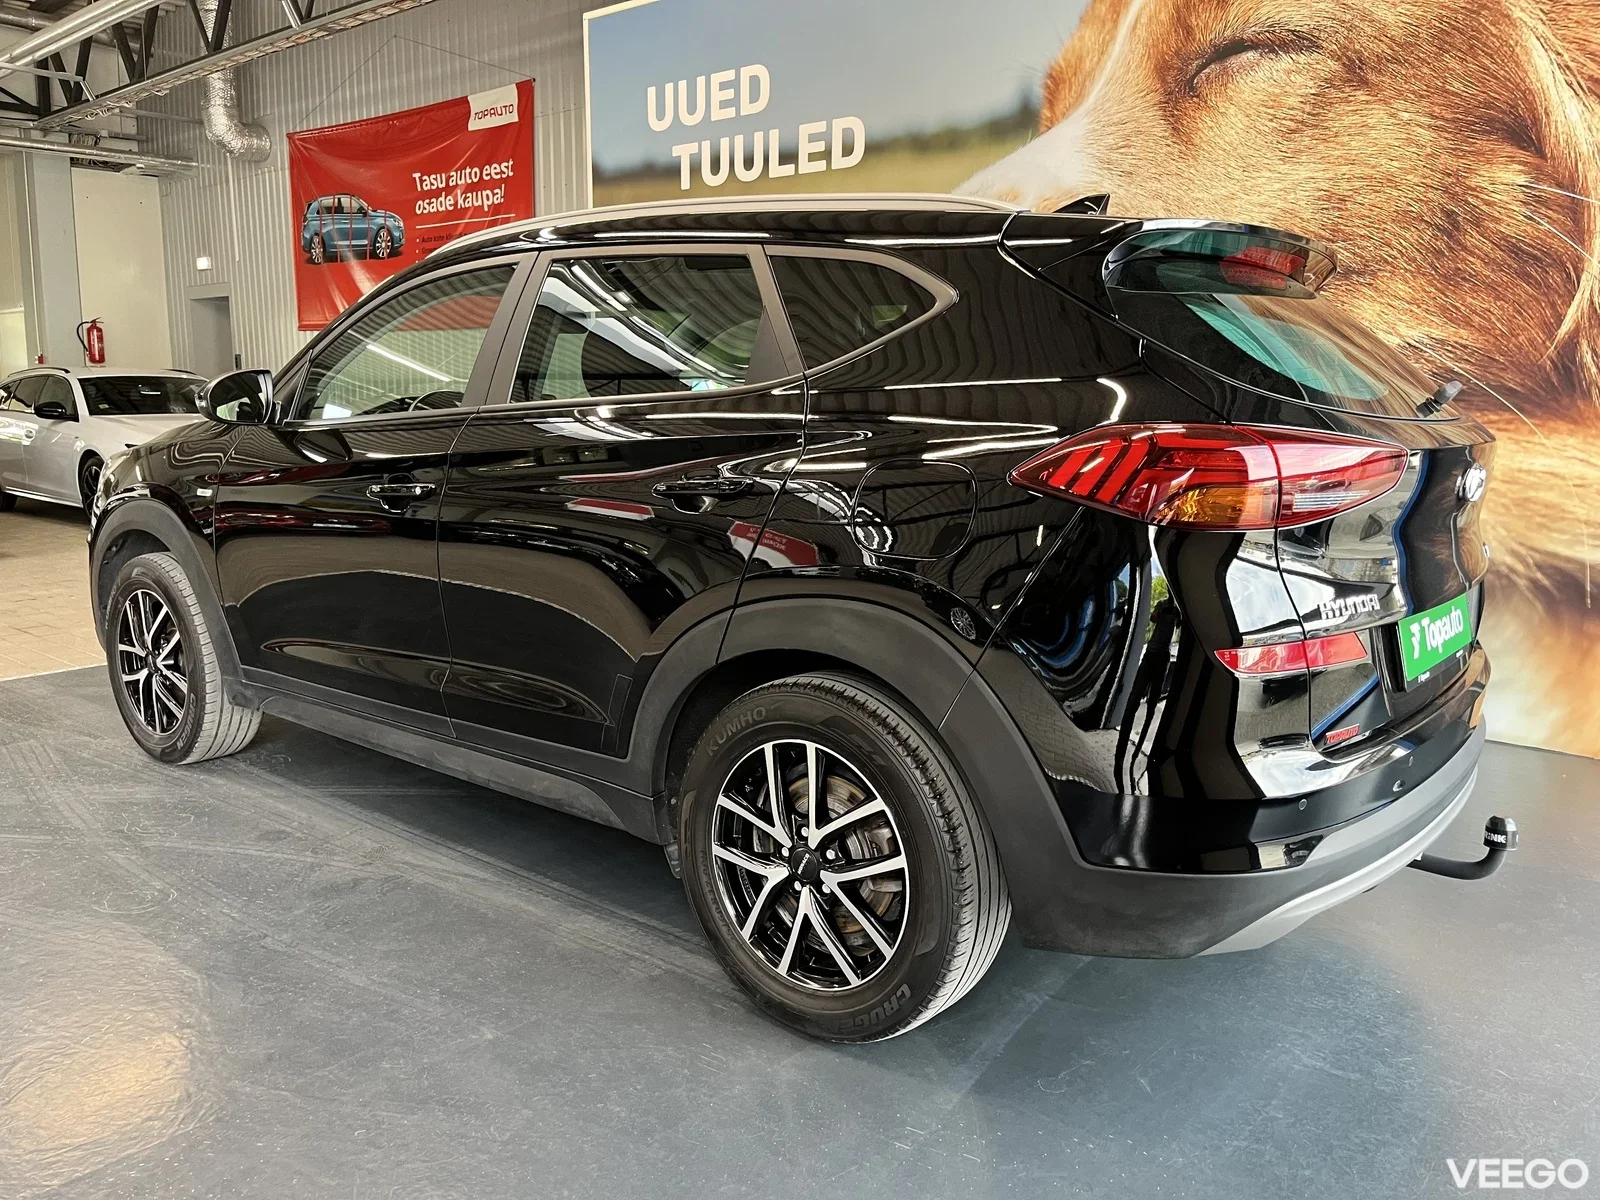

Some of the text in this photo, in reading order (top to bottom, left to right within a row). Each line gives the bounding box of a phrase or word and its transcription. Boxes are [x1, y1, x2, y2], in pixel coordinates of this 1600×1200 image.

[474, 103, 514, 121] TOPAUTO
[647, 64, 771, 132] UUED
[672, 116, 866, 191] TUULED
[412, 158, 514, 192] Tasu auto eest
[415, 183, 505, 215] osade kaupa!
[1320, 593, 1380, 620] HYUNDAI
[1421, 605, 1464, 654] Topauto
[706, 706, 767, 757] KUMHO
